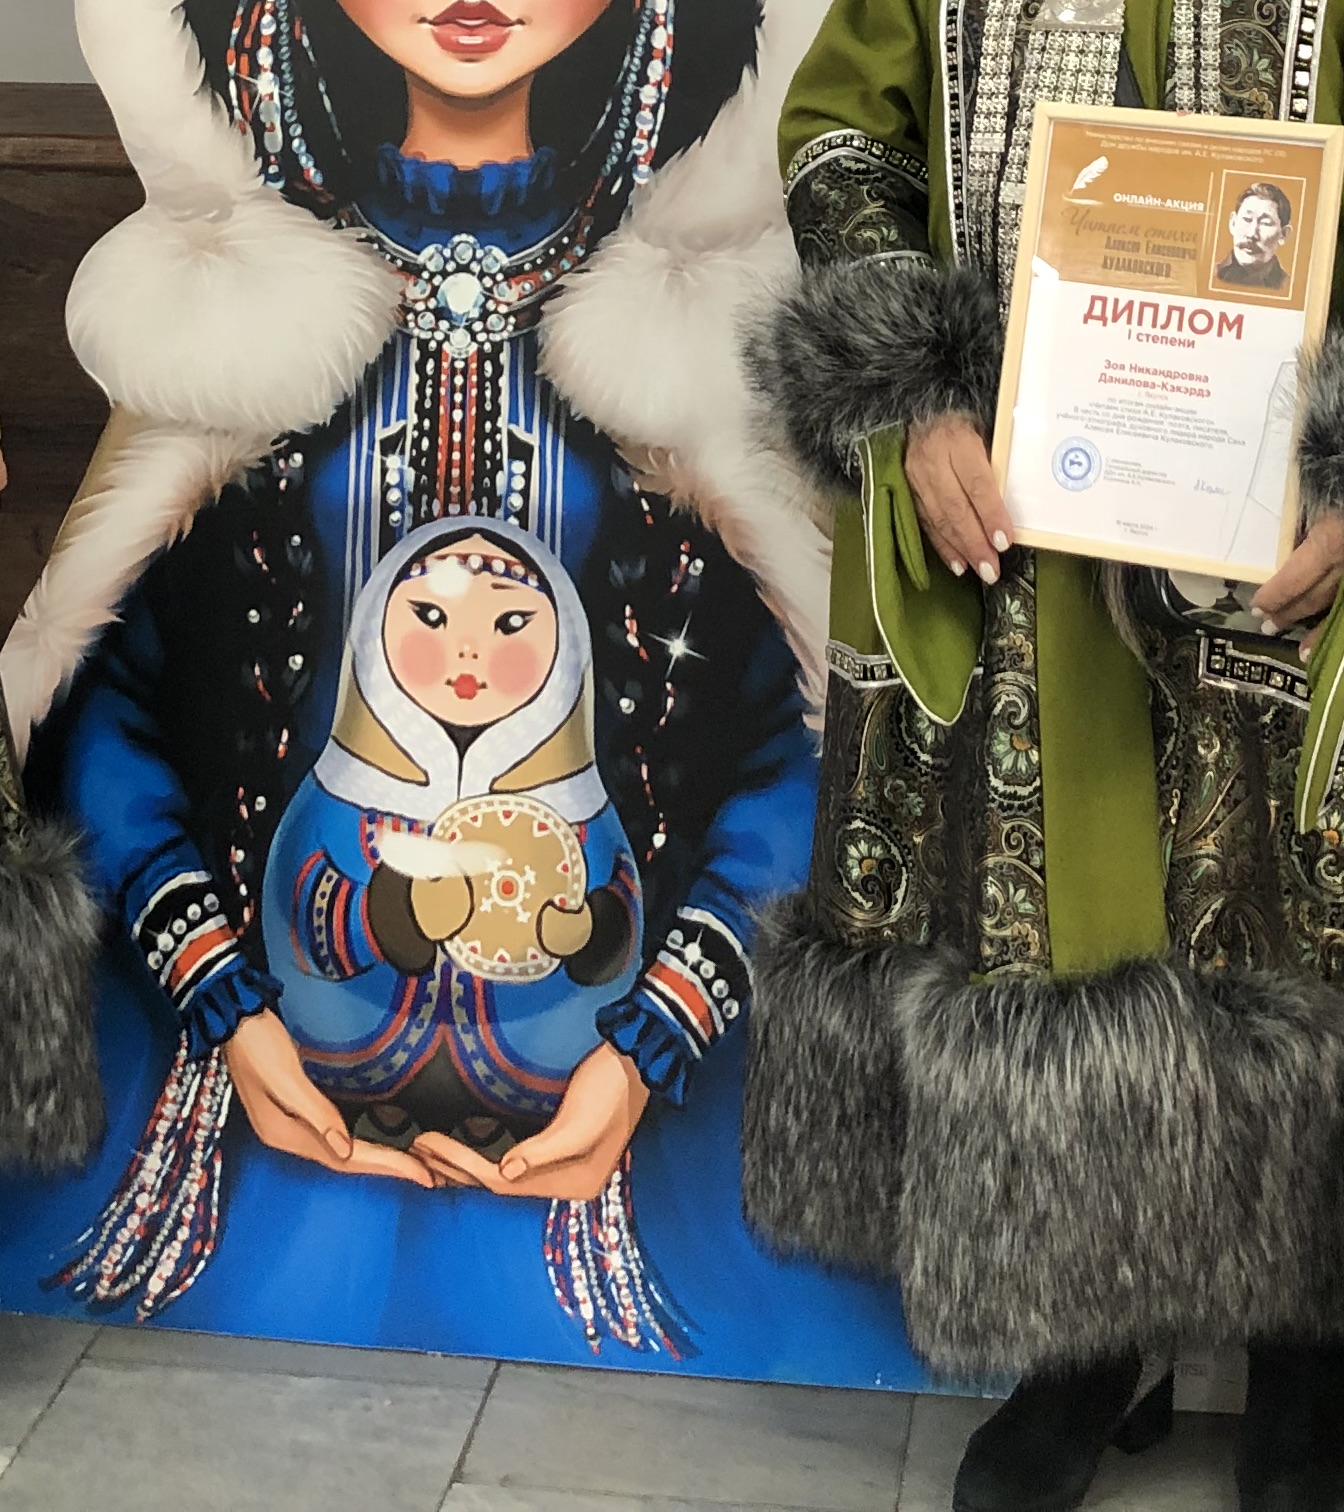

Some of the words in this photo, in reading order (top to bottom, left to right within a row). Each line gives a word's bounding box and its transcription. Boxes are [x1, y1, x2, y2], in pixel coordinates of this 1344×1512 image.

[1113, 192, 1205, 212] ОНЛАЙН-АКЦИЯ
[1083, 294, 1245, 340] ДИПЛОМ
[1136, 331, 1196, 349] степени
[1104, 359, 1126, 372] Зоя
[1129, 363, 1209, 383] Никандровна
